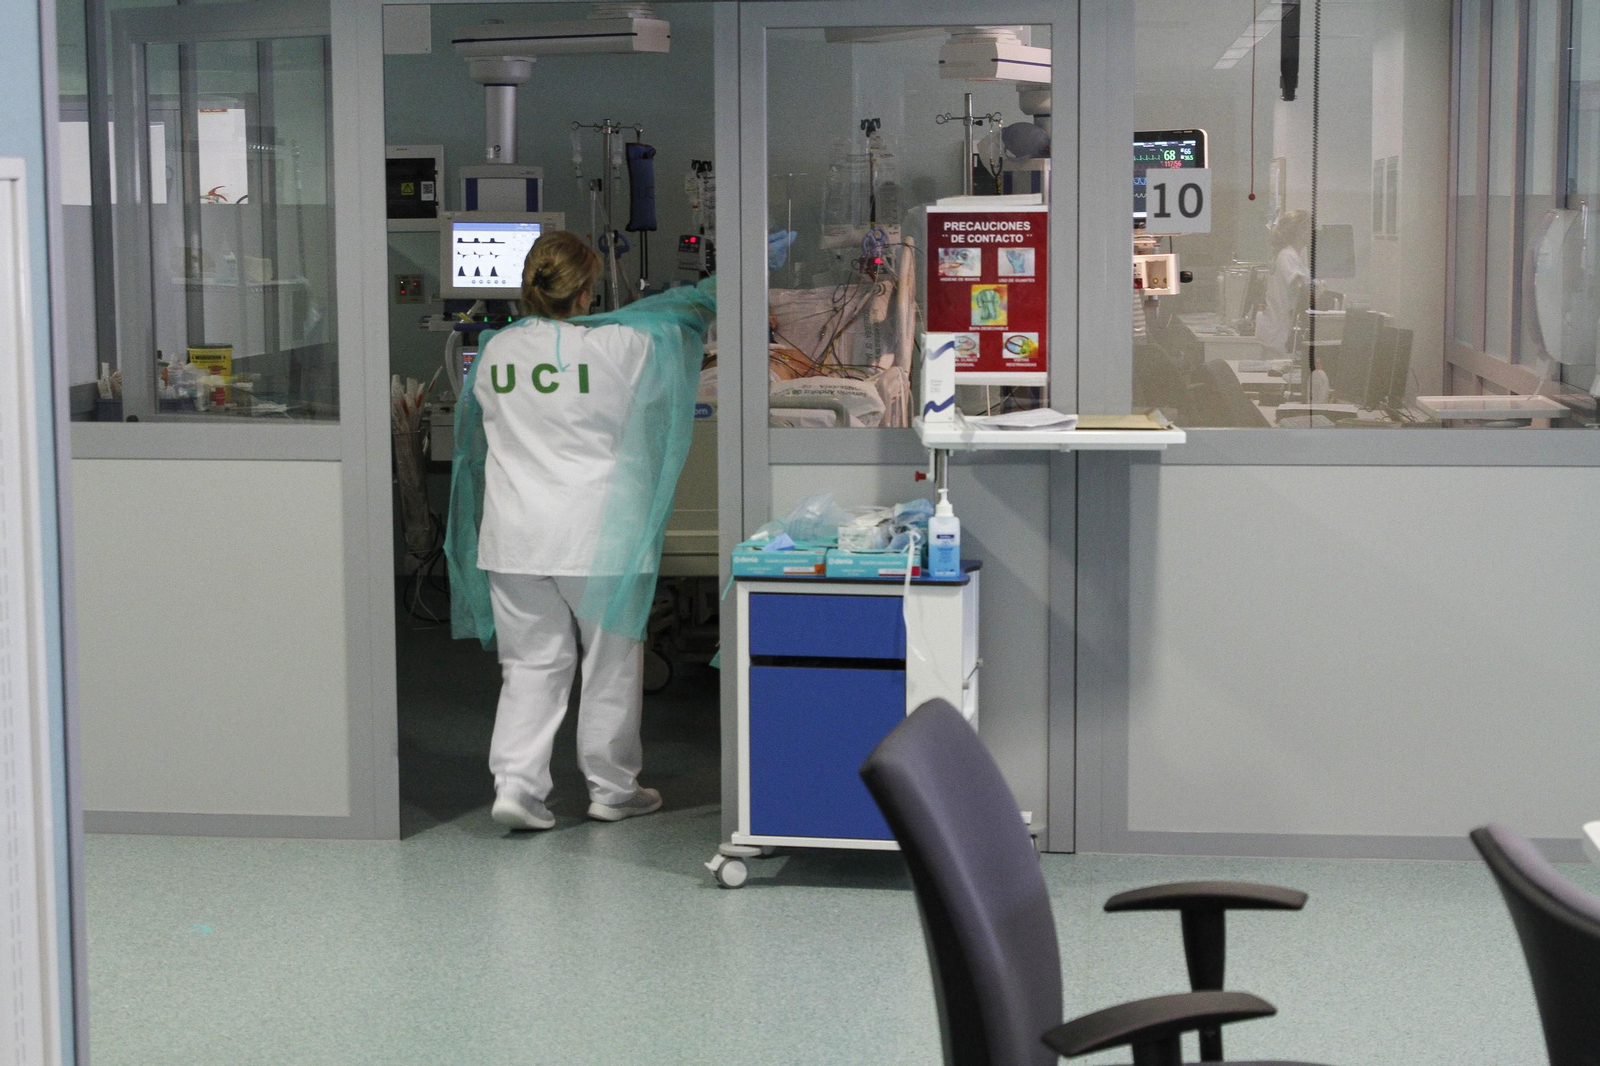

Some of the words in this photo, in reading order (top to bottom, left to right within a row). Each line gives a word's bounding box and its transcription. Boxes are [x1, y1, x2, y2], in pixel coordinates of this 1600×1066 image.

[1164, 150, 1176, 161] 68
[1153, 183, 1204, 218] 10
[943, 221, 1031, 231] PRECAUCIONES
[950, 234, 966, 243] DE
[967, 234, 1024, 243] CONTACTO
[490, 363, 590, 394] UCI
